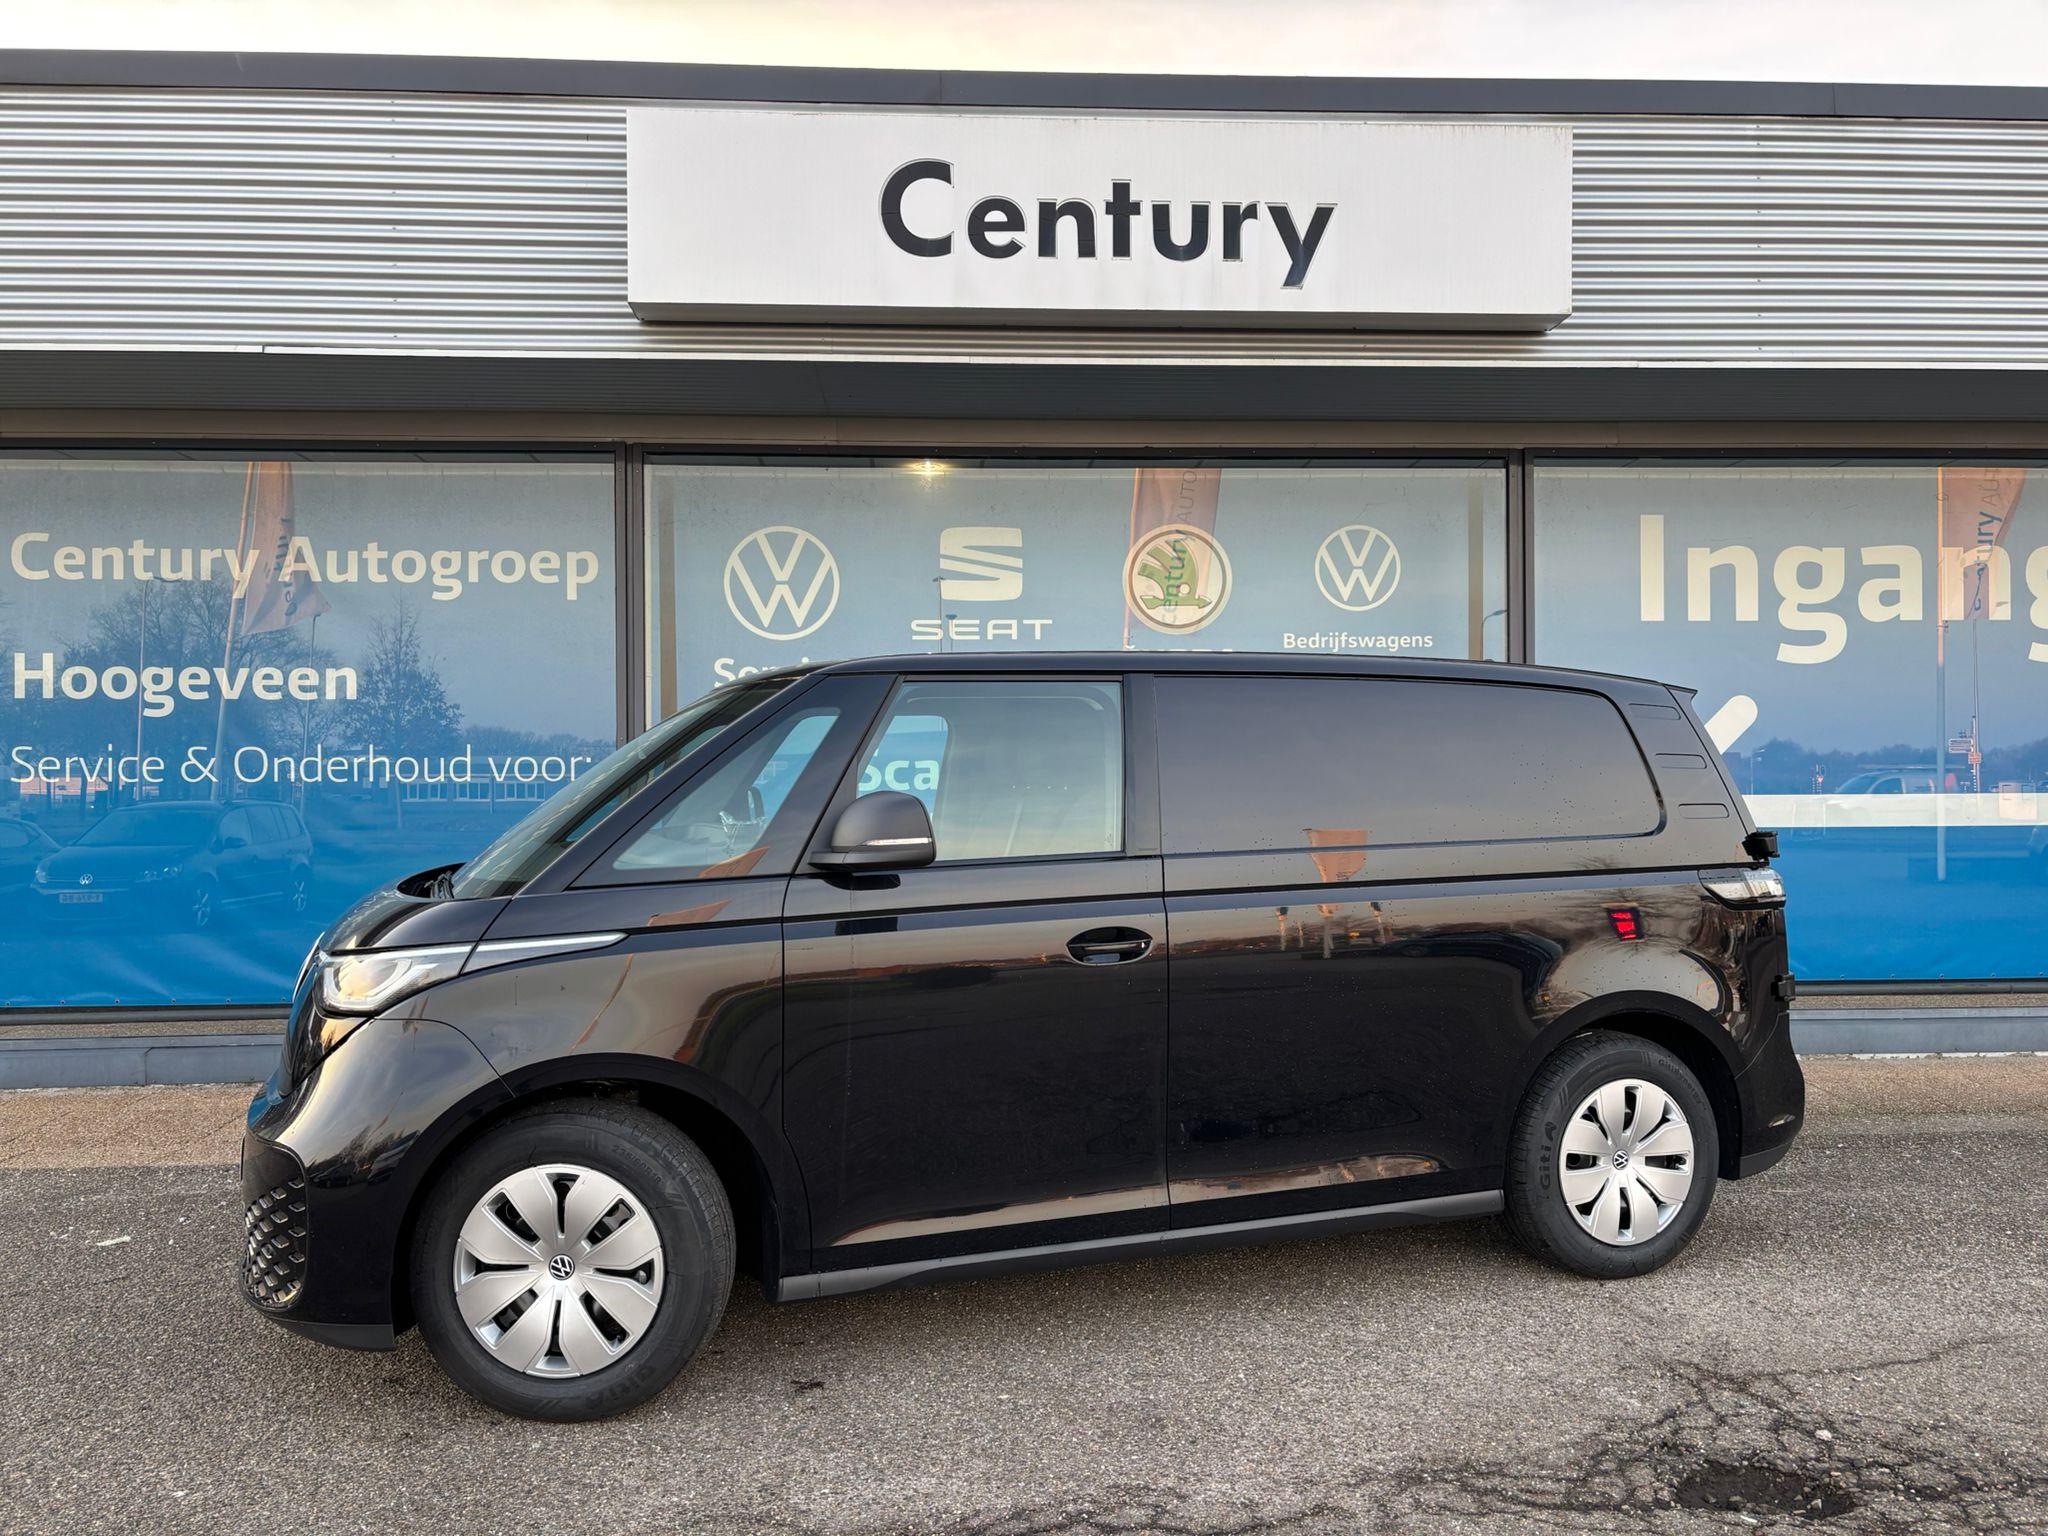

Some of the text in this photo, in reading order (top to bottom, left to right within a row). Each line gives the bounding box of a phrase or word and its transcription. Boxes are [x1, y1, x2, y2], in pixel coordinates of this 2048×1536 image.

[880, 157, 1338, 290] Century
[10, 532, 260, 596] Century
[278, 535, 600, 601] Autogroep
[910, 618, 1054, 641] SEAT
[1282, 631, 1434, 653] Bedrijfswagens
[12, 652, 359, 718] Hoogeveen
[10, 744, 165, 783] Service
[180, 746, 219, 783] &
[233, 744, 473, 783] Onderhoud
